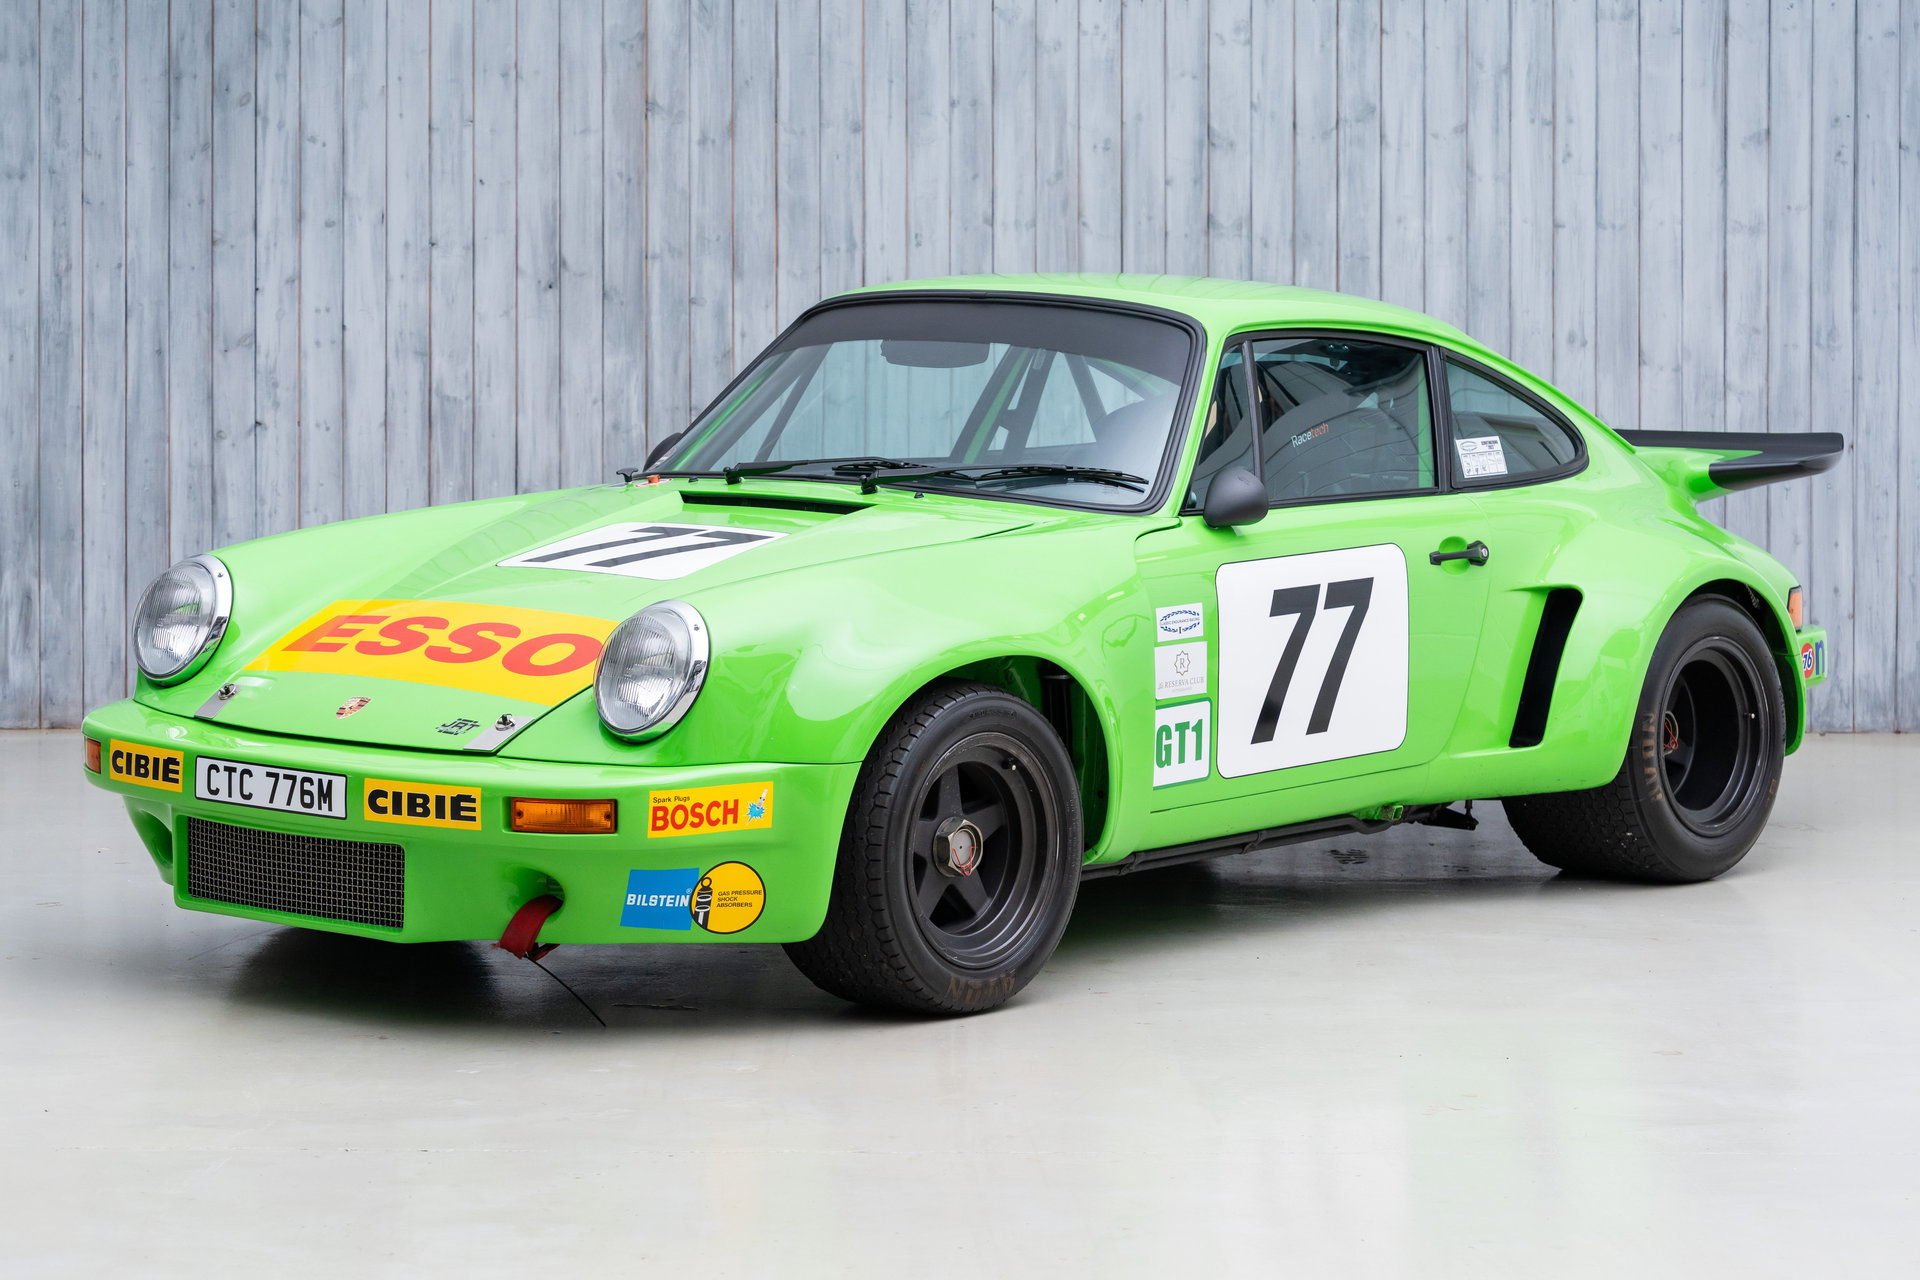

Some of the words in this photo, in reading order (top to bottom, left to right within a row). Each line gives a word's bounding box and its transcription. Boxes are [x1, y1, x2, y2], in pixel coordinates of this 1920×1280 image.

[1290, 422, 1328, 448] Racetech
[520, 526, 775, 568] 77
[280, 615, 601, 677] ESSO
[1250, 576, 1374, 745] 77
[1802, 650, 1812, 670] 76
[1164, 678, 1189, 689] RESERVA
[1189, 676, 1204, 685] CLUB
[1155, 718, 1203, 768] GT1
[206, 763, 253, 801] CTC
[265, 771, 333, 812] 776M
[652, 796, 672, 804] Spark
[674, 795, 690, 803] Plugs
[651, 799, 739, 831] BOSCH
[626, 893, 690, 907] BILSTEIN
